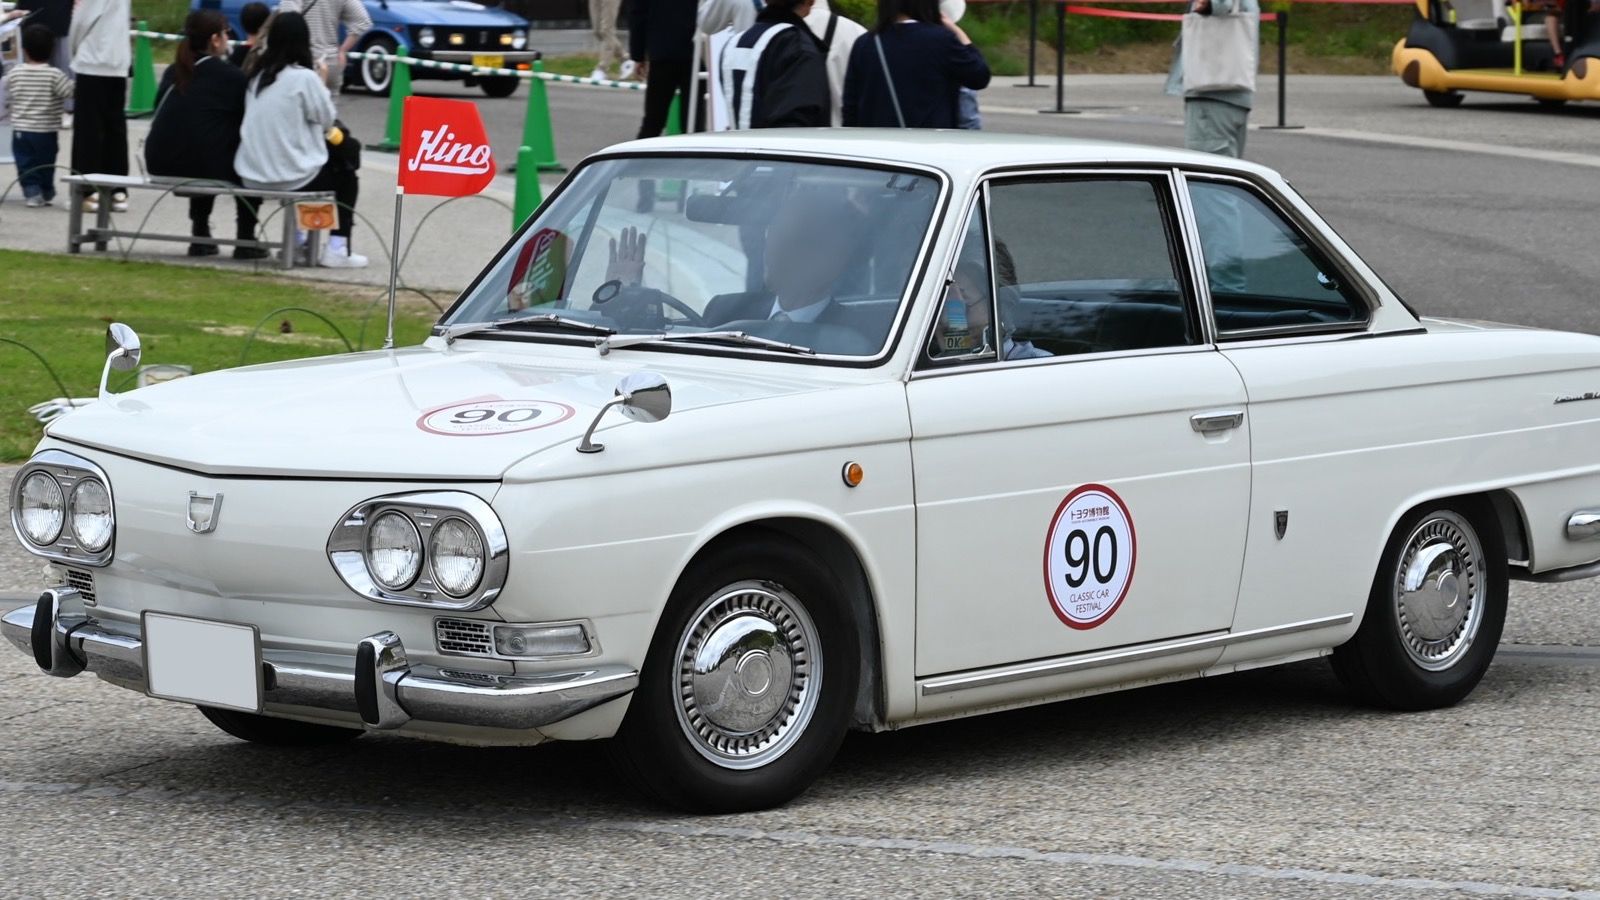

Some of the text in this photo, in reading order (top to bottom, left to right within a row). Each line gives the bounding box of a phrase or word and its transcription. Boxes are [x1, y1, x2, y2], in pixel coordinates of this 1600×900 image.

[408, 124, 491, 175] Hino
[450, 408, 542, 424] 90
[1070, 505, 1110, 520] トヨタ博物館
[1064, 525, 1118, 588] 90
[1070, 589, 1110, 603] CLASSIC CAR
[1075, 602, 1102, 614] FESTIVAL
